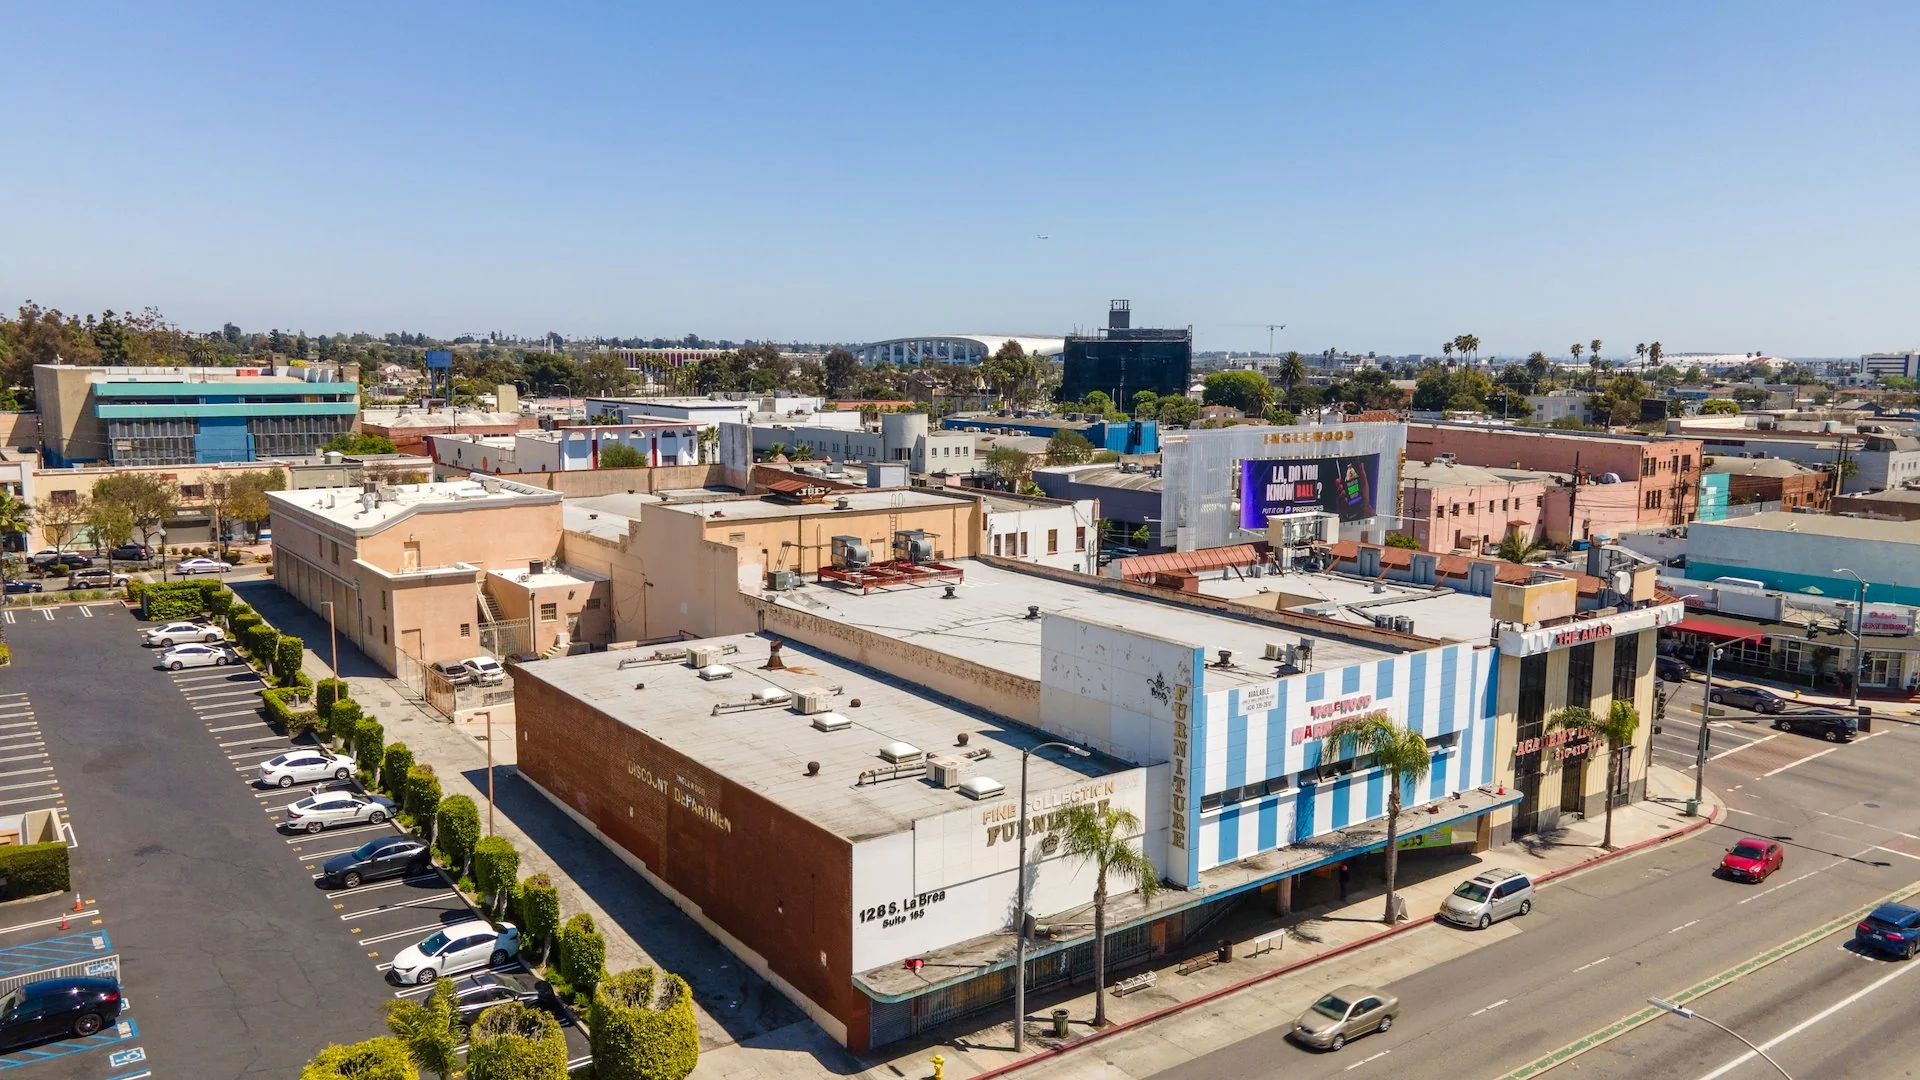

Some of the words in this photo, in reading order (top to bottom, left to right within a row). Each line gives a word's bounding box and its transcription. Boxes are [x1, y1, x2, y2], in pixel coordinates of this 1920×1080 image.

[1263, 430, 1354, 445] INGLEWOOD
[1272, 465, 1287, 484] LA,
[1288, 465, 1301, 482] DO
[1302, 464, 1319, 480] YOU
[1266, 483, 1295, 501] KNOW
[1296, 484, 1313, 497] BALL
[1248, 687, 1270, 698] AVAILABLE
[1310, 694, 1372, 721] INGLEWOOD
[1172, 683, 1188, 850] FURNITURE
[982, 804, 1017, 825] FINE
[859, 904, 886, 924] 128
[888, 901, 901, 915] S.
[903, 898, 917, 912] La
[919, 890, 946, 908] Brea
[882, 915, 907, 929] Suite
